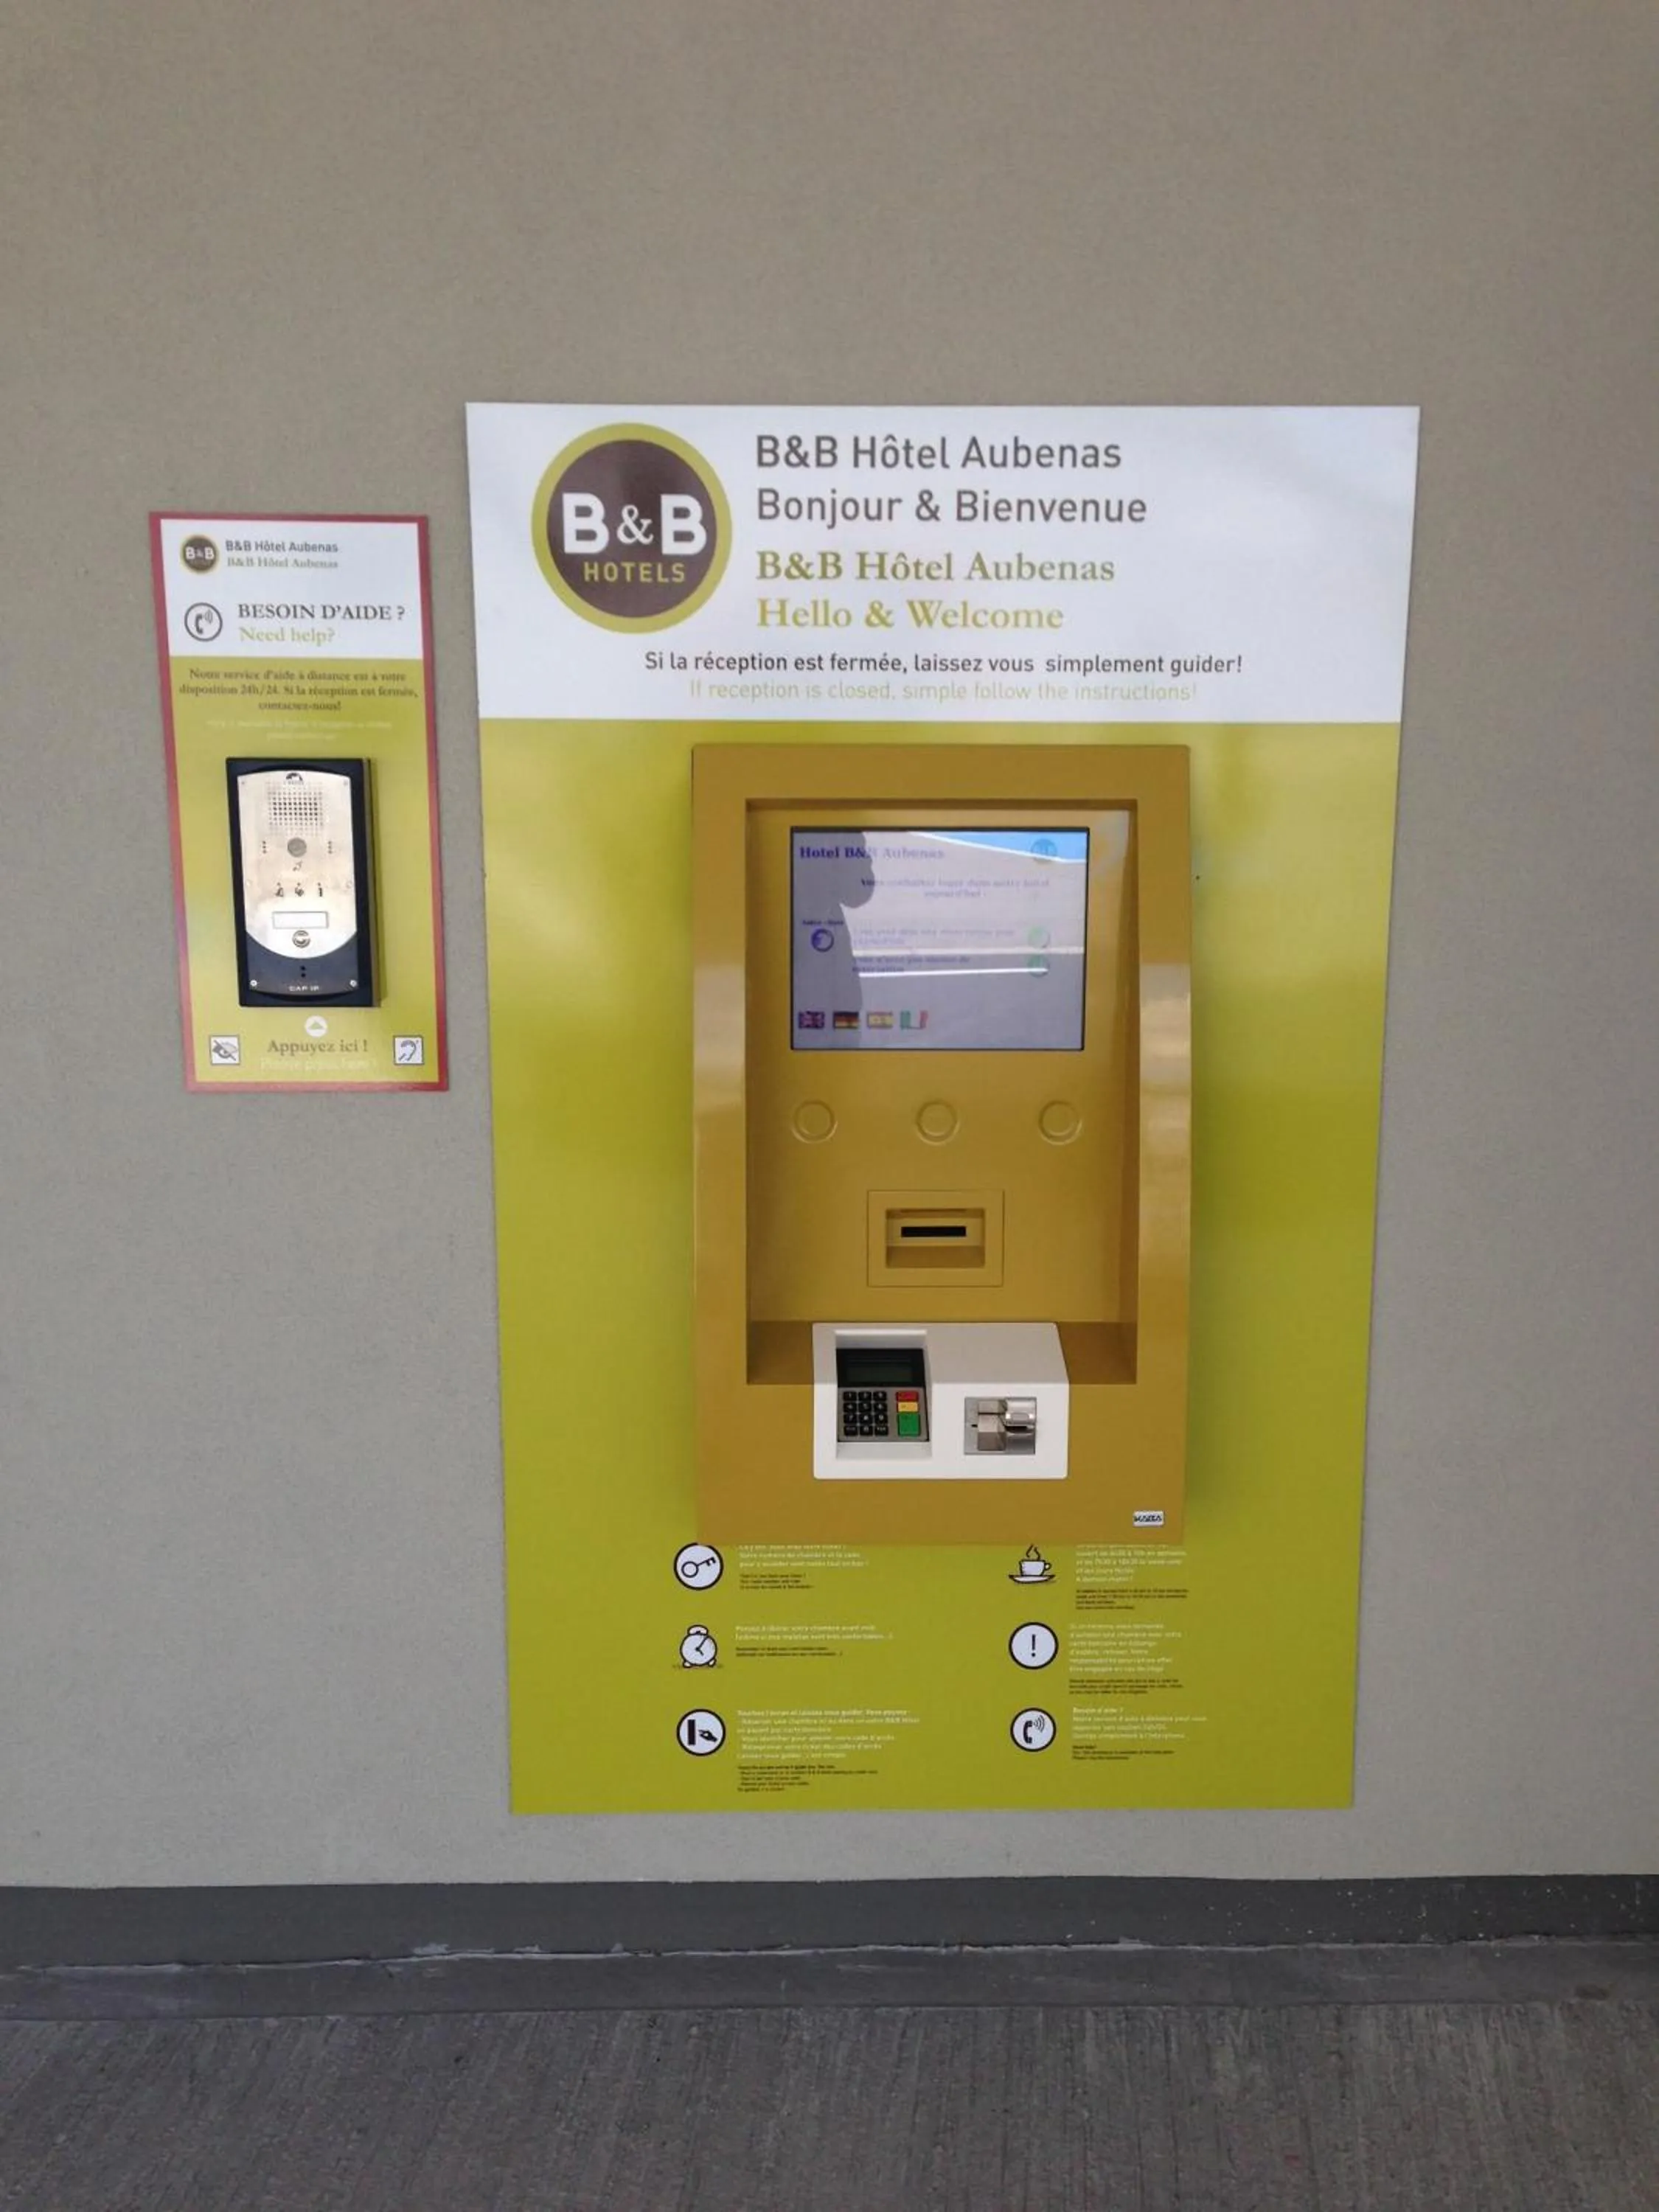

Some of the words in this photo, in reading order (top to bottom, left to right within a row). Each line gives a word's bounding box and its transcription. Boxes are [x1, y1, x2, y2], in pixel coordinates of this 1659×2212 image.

[757, 434, 838, 468] B&B
[853, 434, 949, 468] Hôtel
[961, 436, 1121, 469] Aubenas
[758, 488, 902, 529] Bonjour
[915, 490, 941, 521] &
[956, 489, 1147, 523] Bienvenue
[563, 493, 707, 554] B&B
[226, 540, 251, 552] B&B
[255, 540, 285, 552] Hôtel
[289, 541, 338, 553] Aubenas
[227, 557, 254, 568] B&B
[258, 557, 288, 568] Hôtel
[291, 557, 338, 569] Aubenas
[584, 562, 685, 582] HOTELS
[757, 550, 843, 581] B&B
[857, 550, 954, 581] Hôtel
[966, 552, 1115, 581] Aubenas
[238, 603, 316, 619] BESOIN
[397, 605, 406, 620] ?
[757, 598, 852, 628] Hello
[864, 600, 894, 628] &
[906, 599, 1064, 629] Welcome
[240, 627, 285, 642] Need
[291, 627, 335, 647] help?
[645, 652, 664, 669] Si
[669, 653, 688, 669] la
[695, 651, 787, 675] réception
[794, 655, 824, 672] est
[830, 652, 908, 675] fermée,
[914, 654, 982, 673] laissez
[989, 658, 1034, 673] vous
[1046, 654, 1164, 676] simplement
[1170, 655, 1242, 677] guider!
[189, 669, 220, 681] Notre
[223, 670, 260, 681] service
[307, 669, 350, 681] distance
[708, 680, 799, 702] reception
[806, 681, 821, 699] is
[902, 681, 967, 703] simple
[975, 682, 1032, 701] follow
[1038, 682, 1068, 701] the
[1075, 683, 1197, 701] instructions!
[800, 846, 840, 860] Hotel
[267, 1040, 336, 1057] Appuyez
[340, 1039, 358, 1053] ici
[363, 1040, 369, 1053] !
